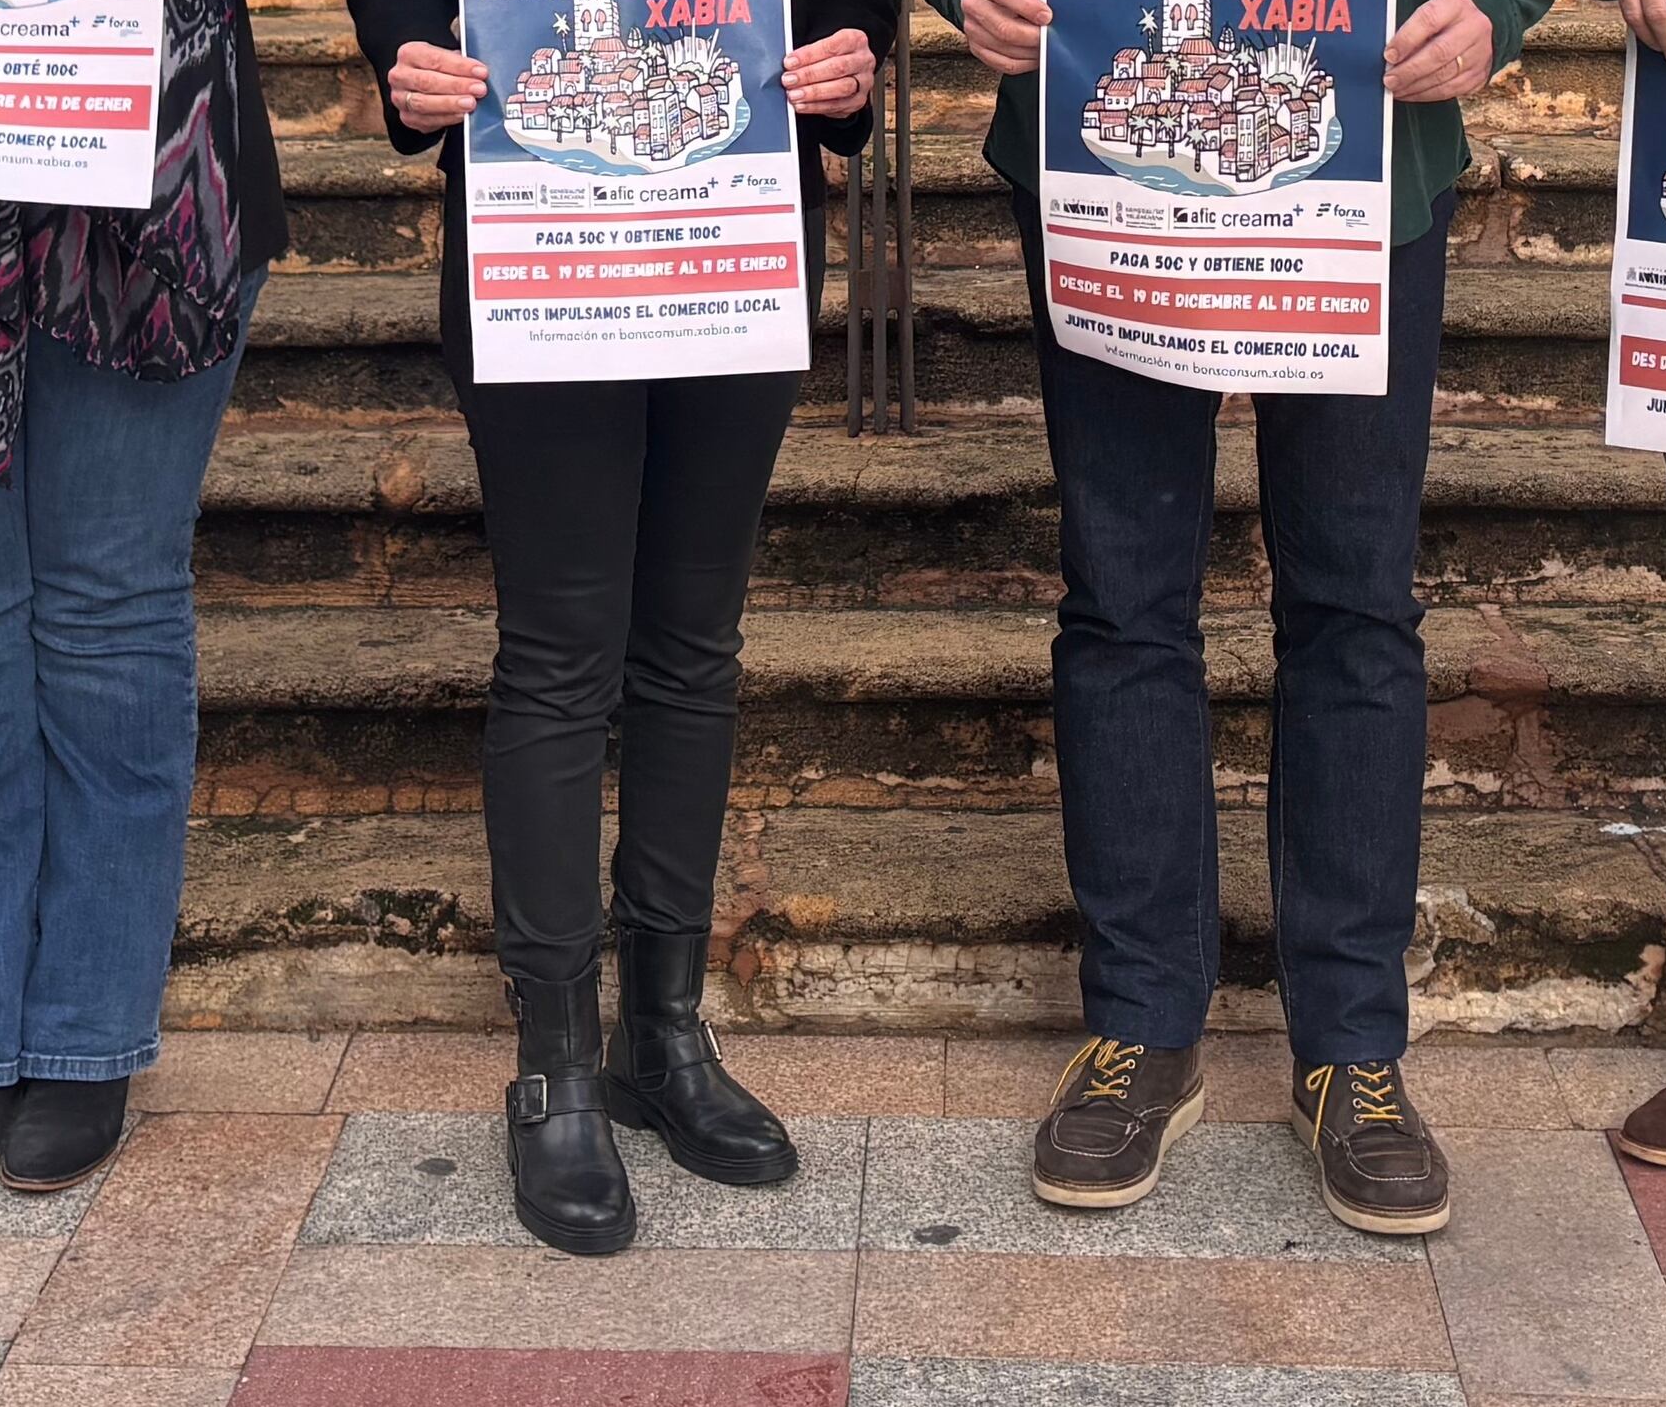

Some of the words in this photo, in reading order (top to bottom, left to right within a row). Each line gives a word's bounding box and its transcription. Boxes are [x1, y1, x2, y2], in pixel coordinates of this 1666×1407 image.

[3, 59, 41, 76] OBTÉ
[46, 63, 78, 77] 100€
[19, 95, 31, 109] A
[61, 96, 82, 112] DE
[85, 97, 133, 112] GENER
[61, 136, 108, 150] LOCAL
[610, 186, 634, 201] afic
[747, 175, 777, 187] forxa
[1191, 207, 1216, 224] afic
[1333, 204, 1366, 218] forxa
[535, 232, 574, 246] PAGA
[609, 231, 619, 244] Y
[624, 228, 684, 244] OBTIENE
[689, 226, 721, 241] 100€
[483, 265, 528, 281] DESDE
[532, 265, 550, 280] EL
[558, 265, 572, 279] 19
[576, 264, 595, 279] DE
[599, 261, 675, 279] DICIEMBRE
[679, 260, 698, 275] AL
[716, 258, 735, 273] DE
[740, 256, 787, 272] ENERO
[1110, 251, 1149, 269] PAGA
[1189, 257, 1198, 272] Y
[1204, 257, 1265, 272] OBTIENE
[1270, 258, 1304, 273] 100€
[1059, 274, 1102, 296] DESDE
[1106, 284, 1124, 300] EL
[1133, 289, 1147, 303] 19
[1151, 291, 1170, 306] DE
[1175, 293, 1253, 310] DICIEMBRE
[1257, 295, 1277, 311] AL
[1296, 296, 1316, 312] DE
[1320, 297, 1370, 313] ENERO
[487, 308, 539, 322] JUNTOS
[545, 306, 631, 321] IMPULSAMOS
[636, 305, 653, 319] EL
[659, 301, 729, 317] COMERCIO
[734, 298, 781, 313] LOCAL
[1065, 313, 1114, 336] JUNTOS
[1118, 326, 1206, 353] IMPULSAMOS
[1211, 340, 1229, 355] EL
[1234, 341, 1307, 357] COMERCIO
[1312, 343, 1360, 359] LOCAL
[1631, 351, 1656, 368] DES
